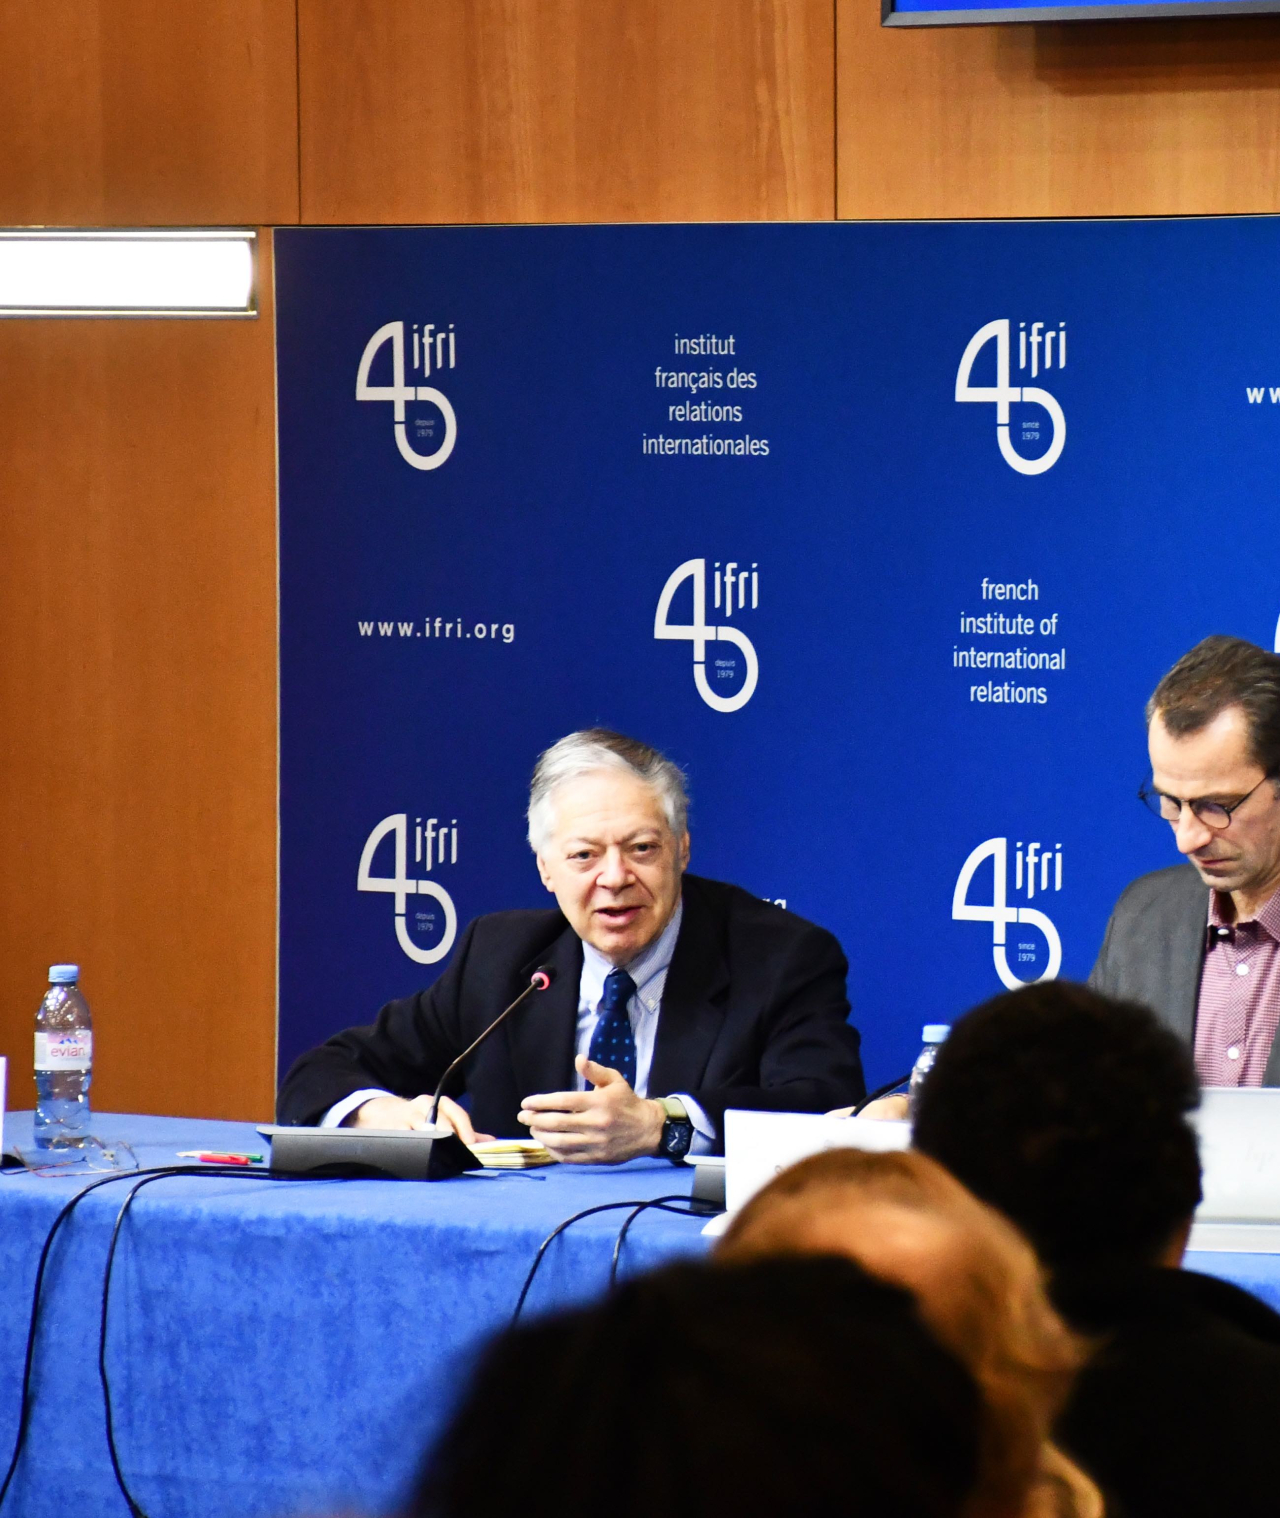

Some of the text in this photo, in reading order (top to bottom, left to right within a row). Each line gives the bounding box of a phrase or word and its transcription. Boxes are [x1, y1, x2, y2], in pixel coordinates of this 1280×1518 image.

[413, 324, 455, 377] ifri
[675, 334, 735, 355] institut
[1020, 322, 1066, 377] ifri
[655, 367, 757, 393] français des
[669, 401, 742, 421] relations
[1021, 421, 1040, 429] since
[1021, 431, 1040, 441] 1979
[643, 434, 769, 455] internationales
[715, 563, 758, 617] ifri
[981, 578, 1038, 600] french
[358, 618, 514, 643] www.ifri.org
[961, 612, 1058, 635] institute of
[714, 659, 736, 668] depuis
[954, 646, 1065, 670] international
[716, 669, 735, 679] 1979
[971, 681, 1047, 704] relations
[416, 818, 457, 871] ifri
[1016, 842, 1062, 898] ifri
[1017, 942, 1036, 951] since
[1017, 952, 1036, 962] 1979
[51, 1046, 84, 1057] evian
